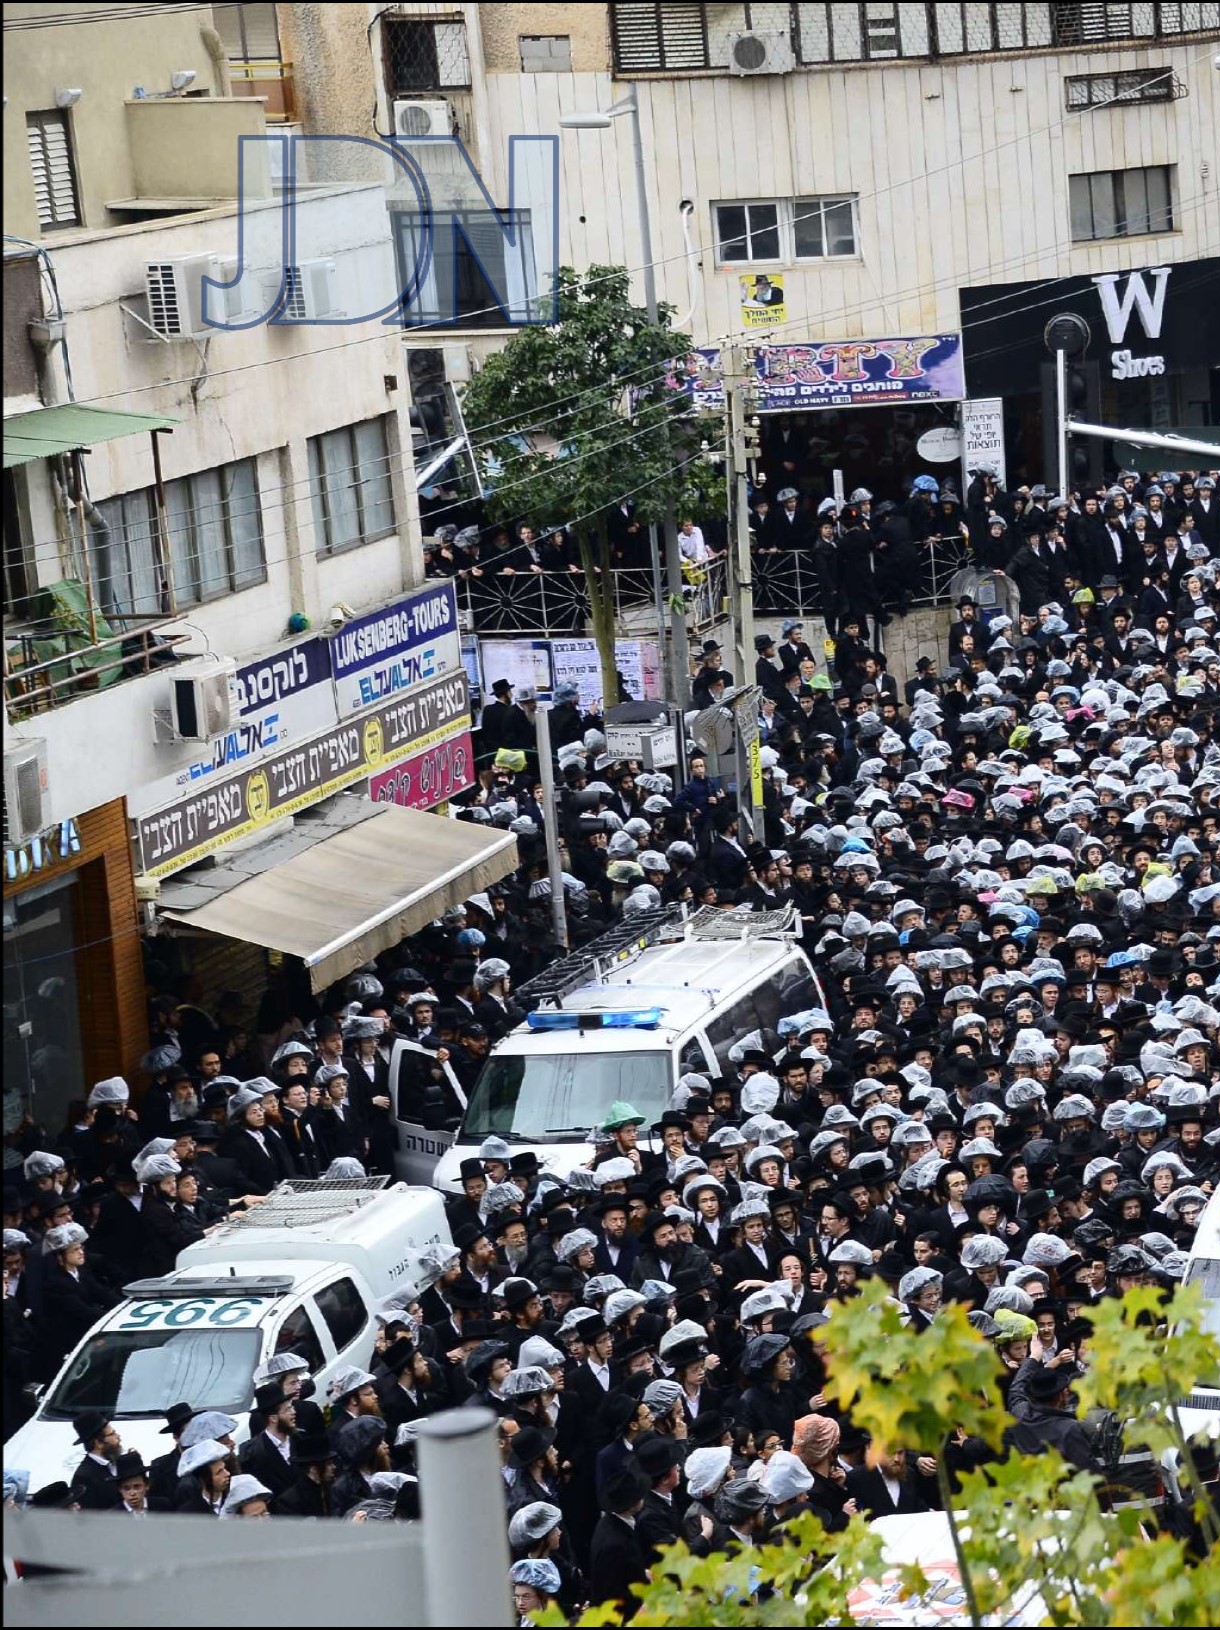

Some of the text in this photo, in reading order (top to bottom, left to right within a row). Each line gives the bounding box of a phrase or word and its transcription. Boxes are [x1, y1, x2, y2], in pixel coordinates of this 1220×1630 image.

[1092, 267, 1172, 344] W
[851, 380, 903, 393] מותגים
[1112, 350, 1165, 380] Shoes
[801, 383, 848, 396] לילדים
[967, 440, 1001, 450] תוצאות
[334, 593, 450, 669] LUKSENBERG-TOURS
[227, 648, 308, 708] לוקסנב
[385, 702, 417, 743] הצבי
[419, 680, 465, 729] מאפיית
[271, 752, 306, 797] הצבי
[309, 728, 360, 782] מאפיית
[751, 745, 760, 780] 375
[186, 783, 242, 841] מאפיית
[144, 811, 183, 859] הצבי
[407, 1134, 450, 1158] שטרה
